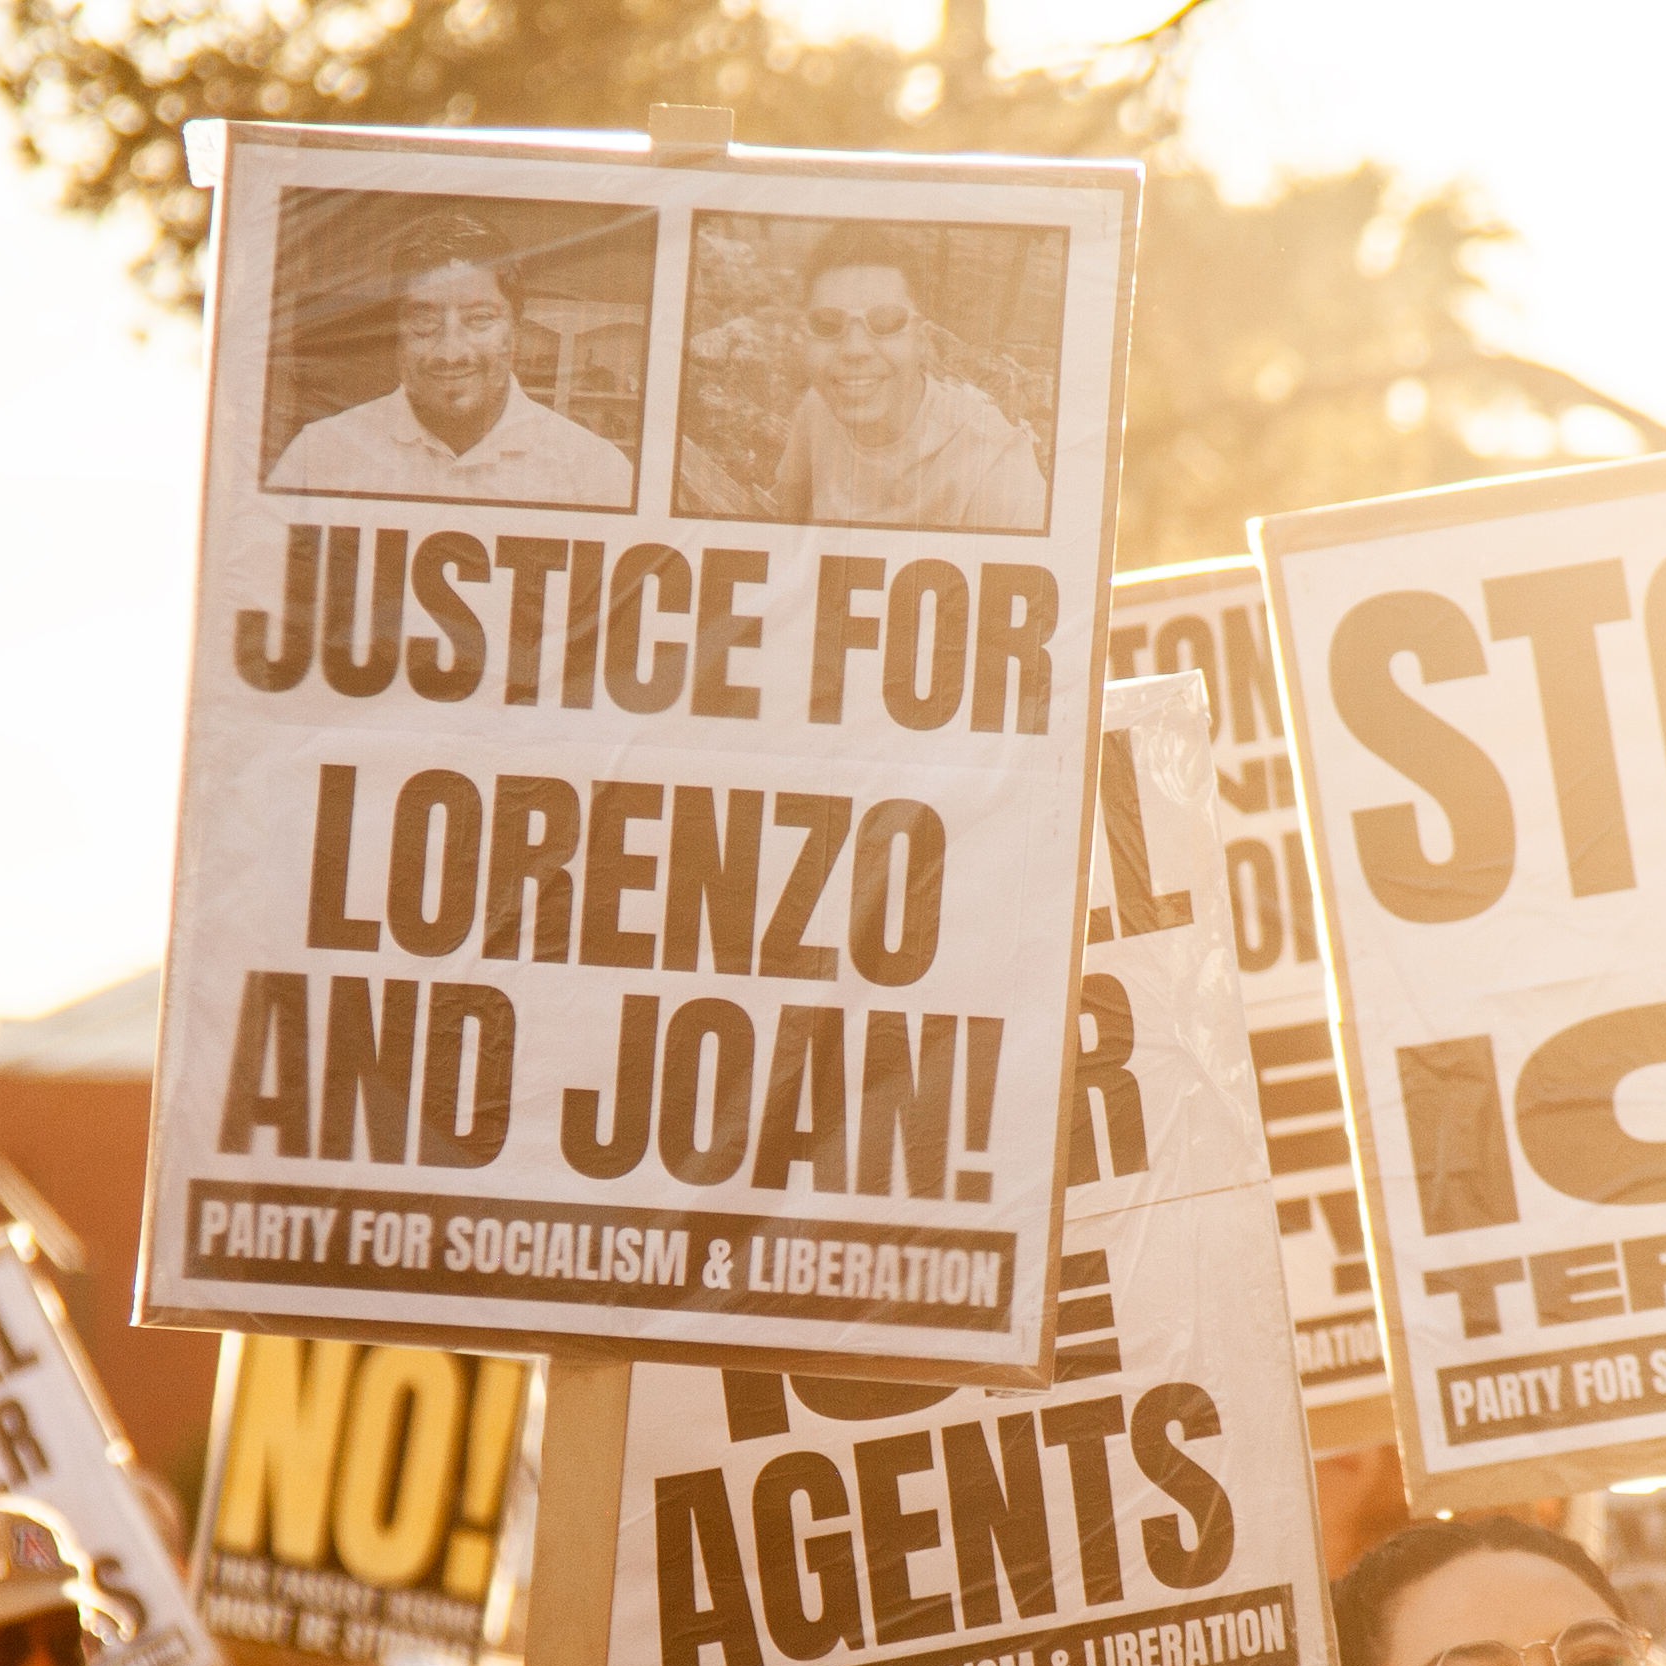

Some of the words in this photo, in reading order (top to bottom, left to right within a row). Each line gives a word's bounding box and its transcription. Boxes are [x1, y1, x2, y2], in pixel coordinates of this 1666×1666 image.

[234, 523, 769, 719] JUSTICE
[808, 554, 1060, 736] FOR
[306, 763, 946, 987] LORENZO
[217, 969, 515, 1169] AND
[560, 993, 1006, 1204] JOAN!
[200, 1202, 338, 1263] PARTY
[348, 1211, 432, 1271] FOR
[445, 1218, 686, 1289] SOCIALISM
[703, 1237, 734, 1290] &
[747, 1237, 1000, 1307] LIBERATION
[215, 1332, 529, 1597] NO!
[1451, 1367, 1562, 1428] PARTY
[1573, 1353, 1642, 1404] FOR
